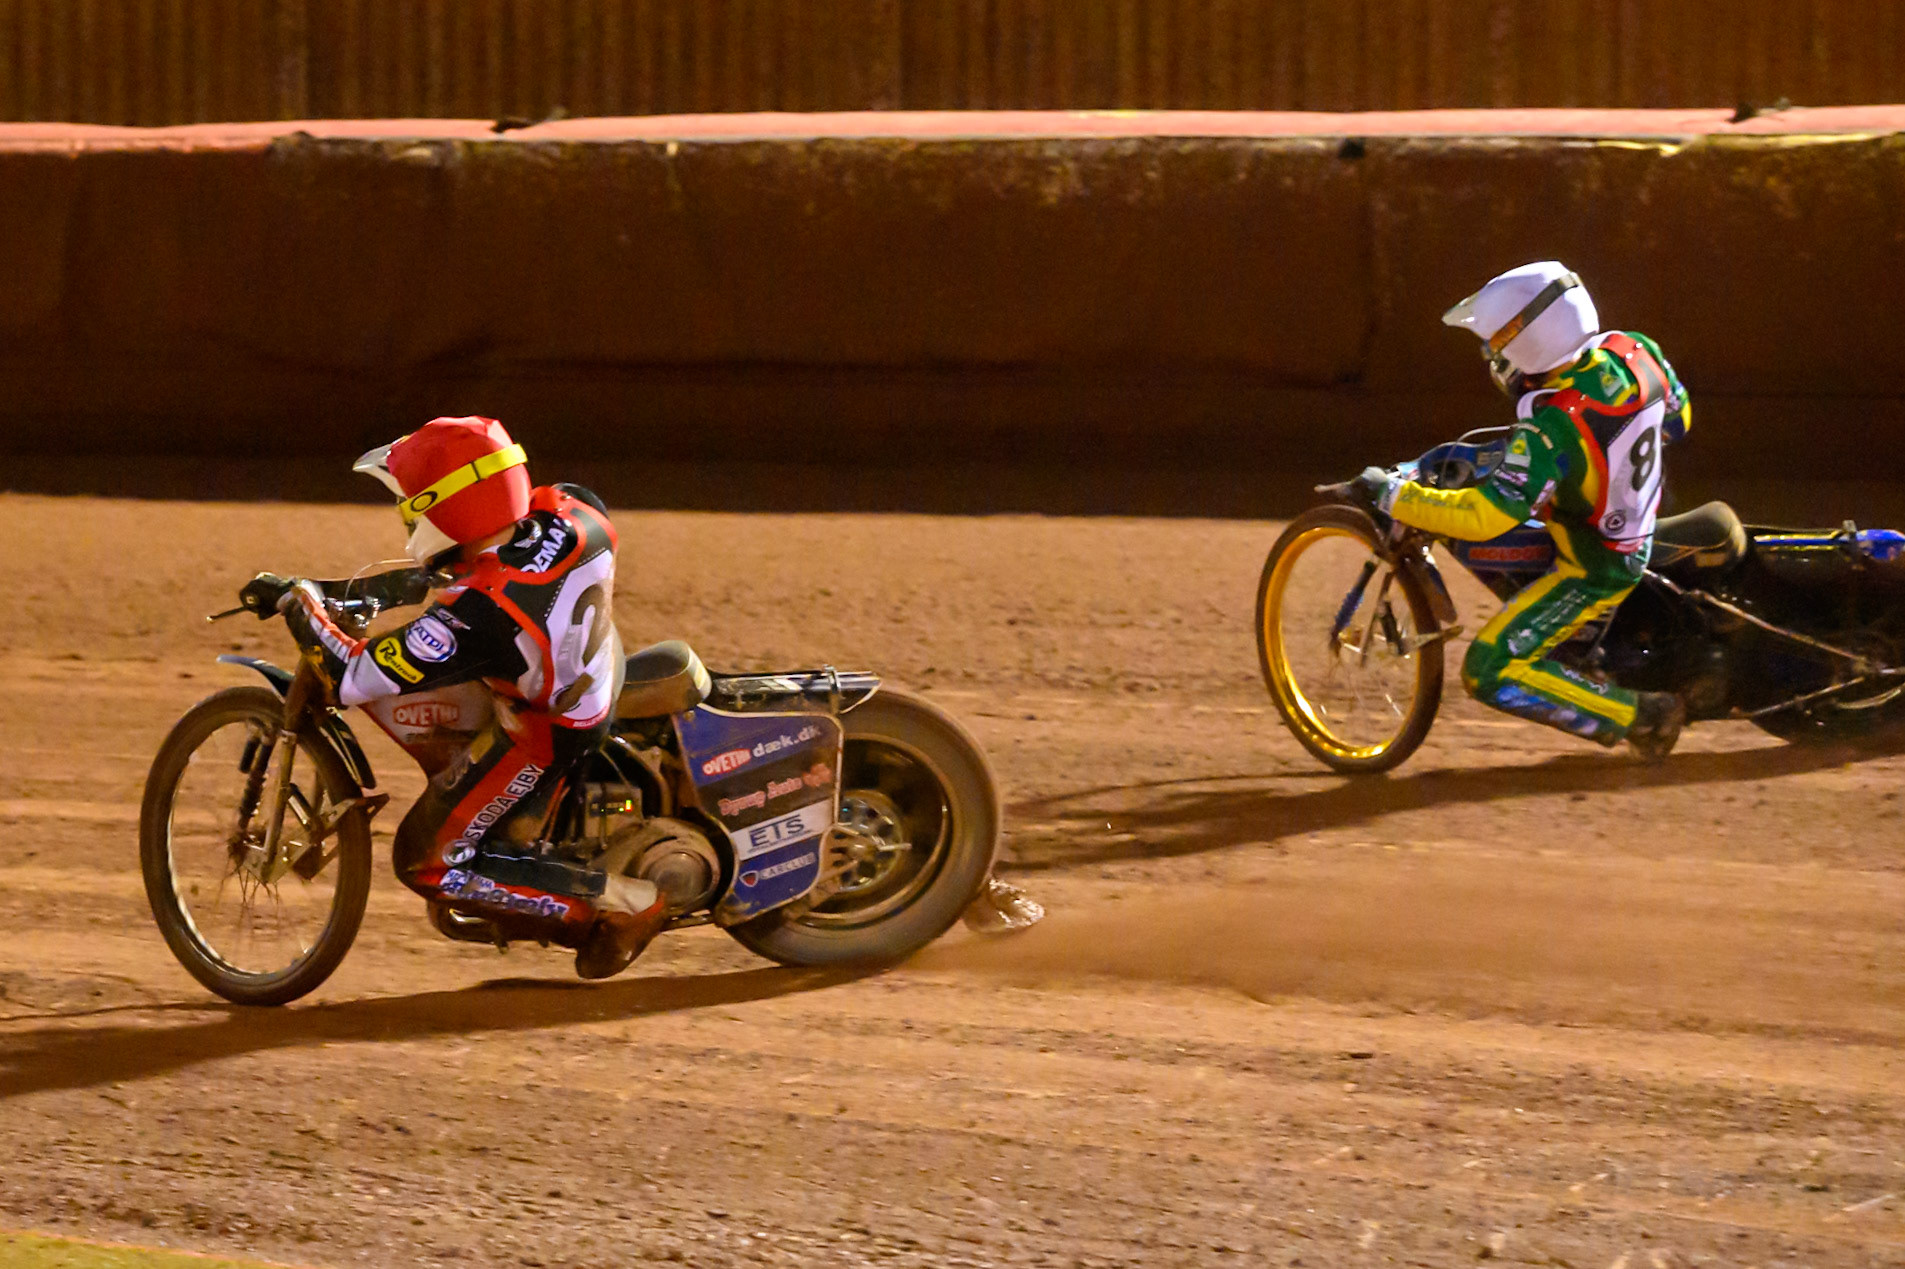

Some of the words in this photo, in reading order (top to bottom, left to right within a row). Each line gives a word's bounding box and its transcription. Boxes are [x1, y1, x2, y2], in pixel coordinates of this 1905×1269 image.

[1629, 426, 1658, 492] 8
[555, 583, 612, 716] 2
[463, 796, 517, 840] SKODA
[749, 813, 805, 848] ETS
